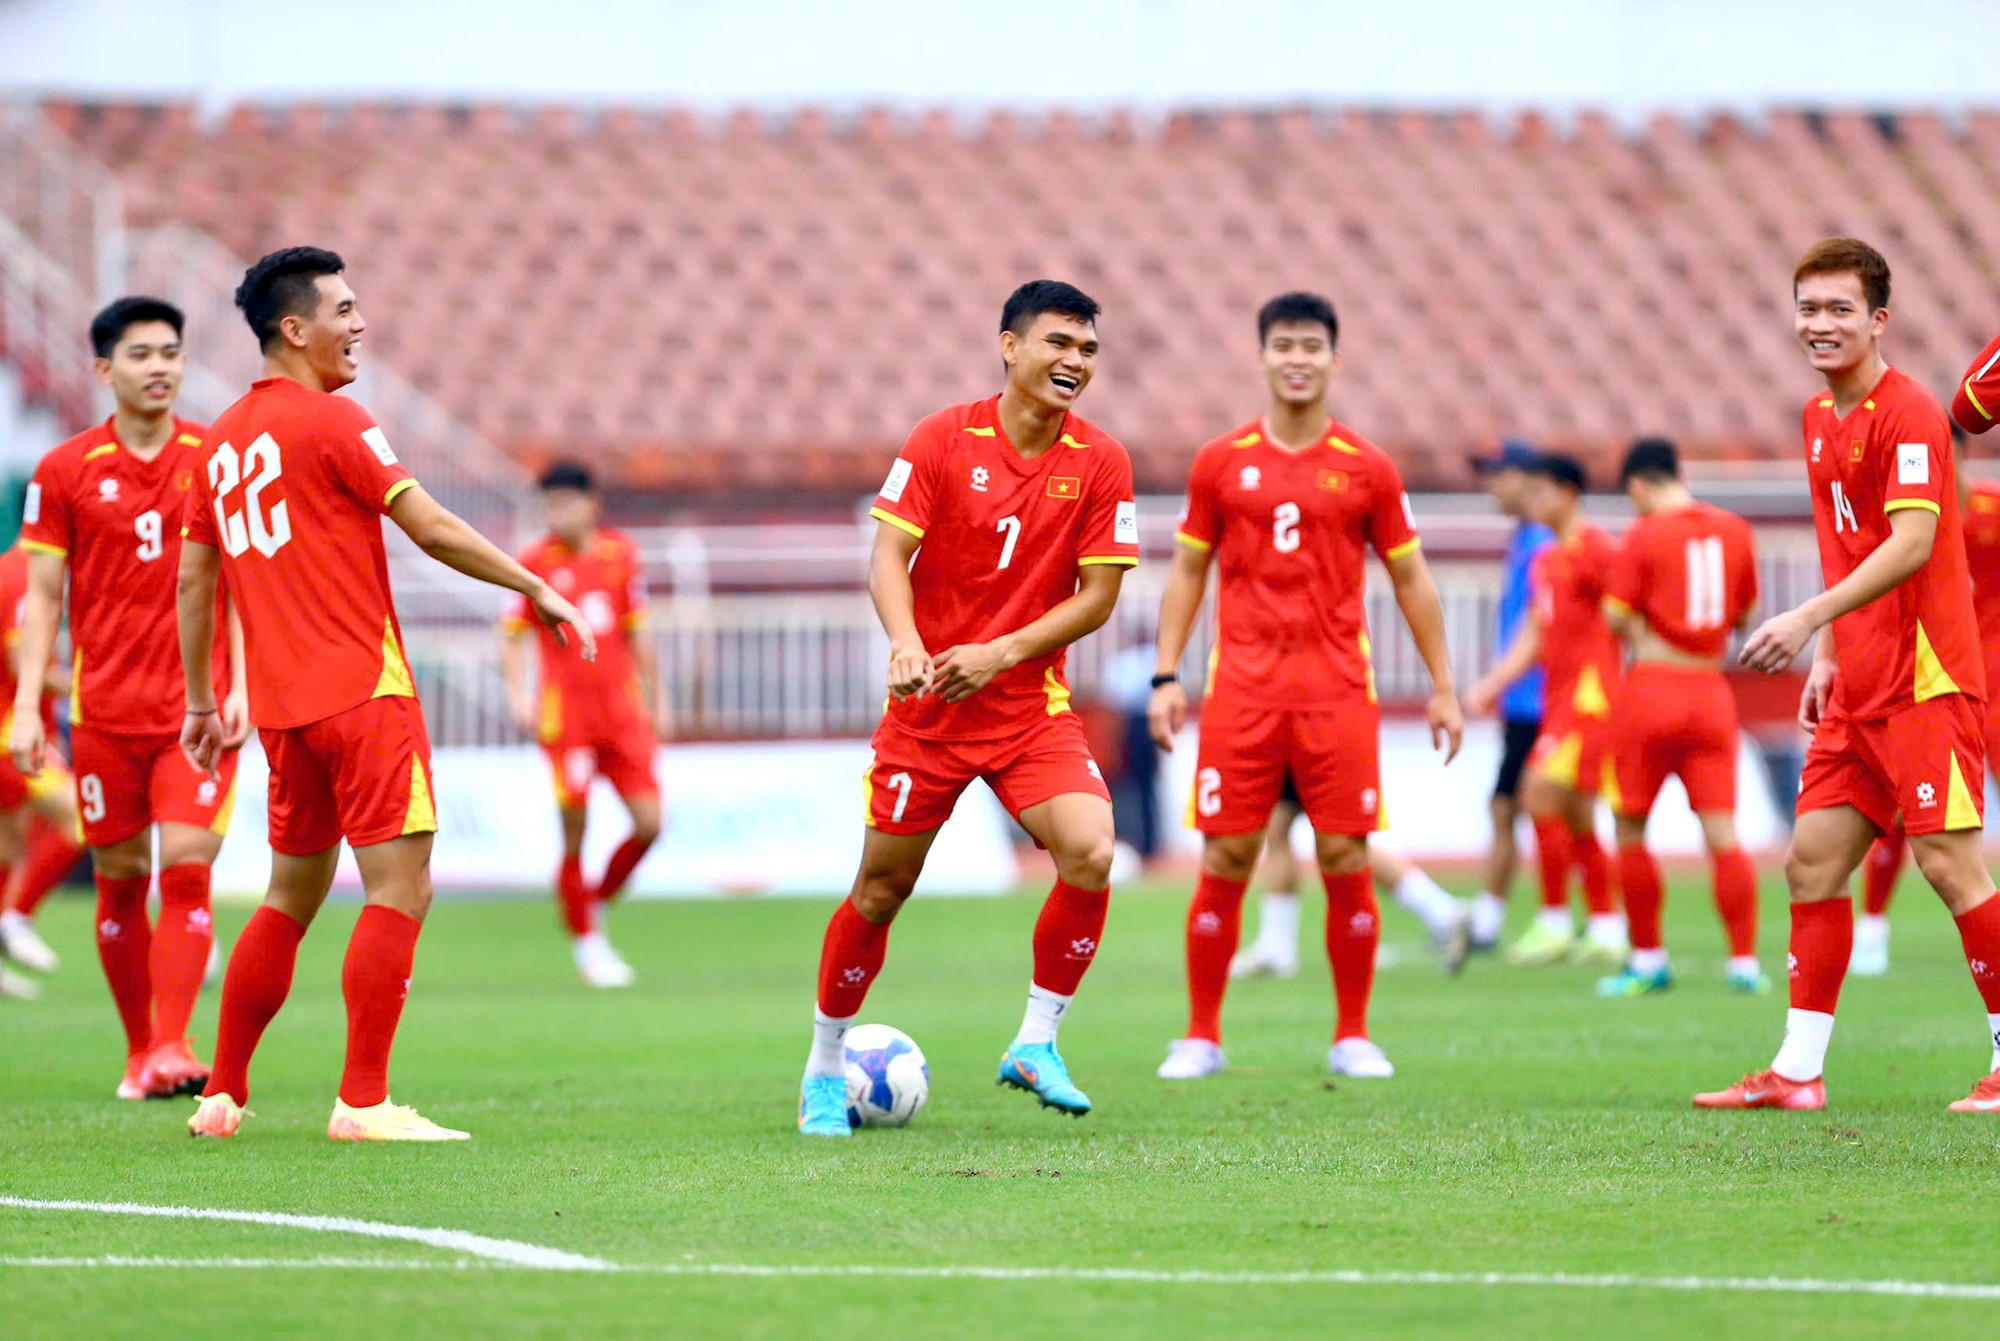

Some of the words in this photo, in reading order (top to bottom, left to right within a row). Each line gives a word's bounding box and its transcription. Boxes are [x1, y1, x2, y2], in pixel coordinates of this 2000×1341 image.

[207, 431, 292, 558] 22
[1830, 480, 1859, 533] 14
[134, 510, 163, 563] 9
[996, 514, 1022, 570] 7
[1272, 501, 1301, 554] 2
[1685, 536, 1726, 630] 11
[81, 773, 106, 823] 9
[887, 772, 913, 823] 7
[1197, 766, 1222, 816] 2
